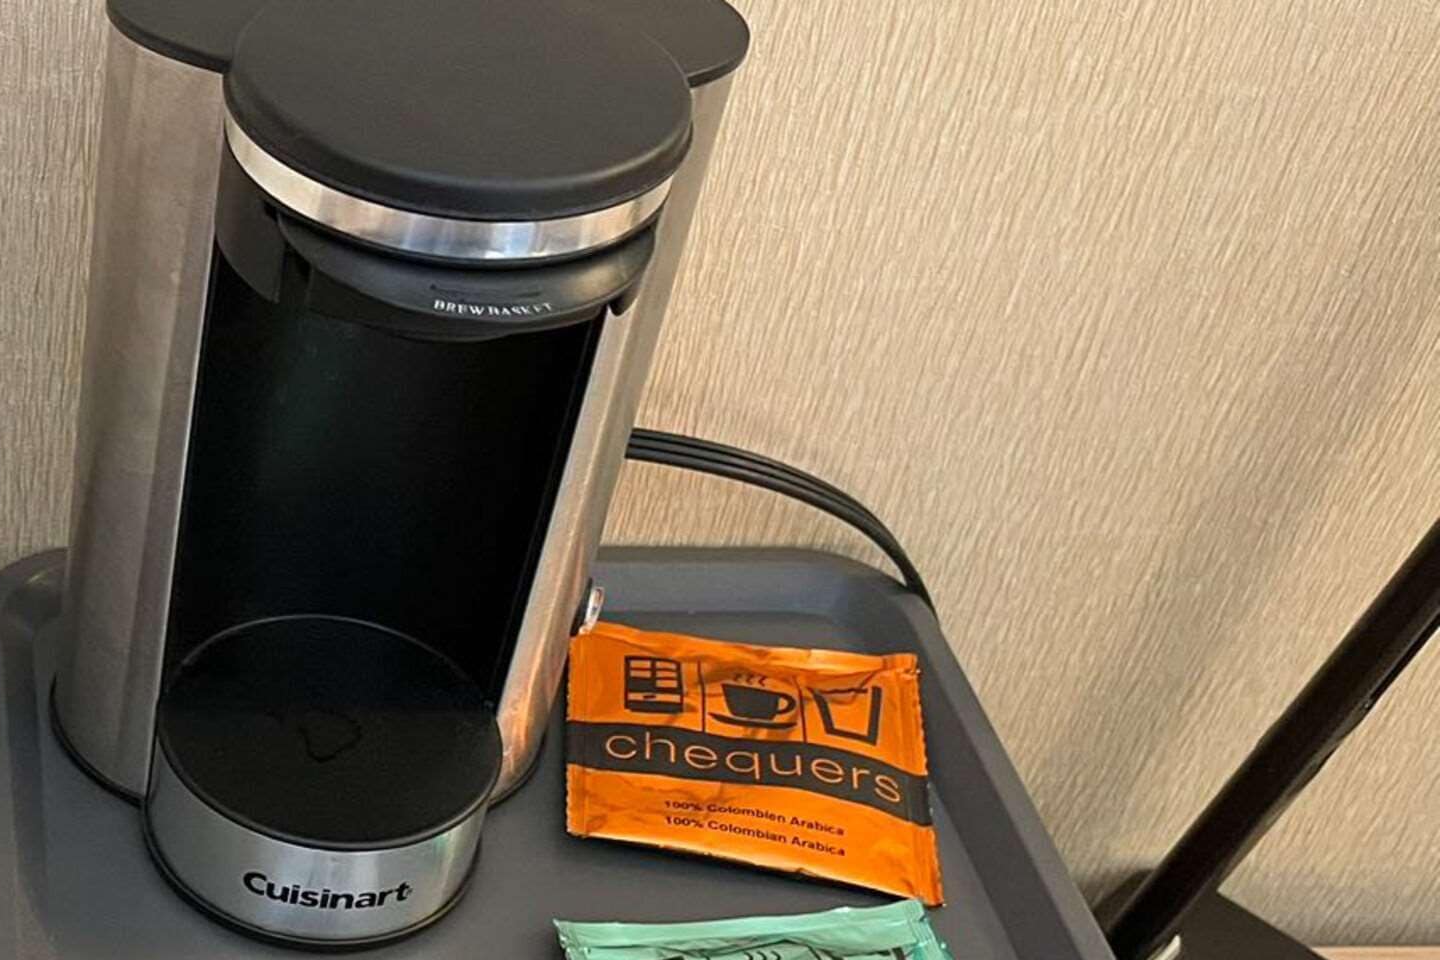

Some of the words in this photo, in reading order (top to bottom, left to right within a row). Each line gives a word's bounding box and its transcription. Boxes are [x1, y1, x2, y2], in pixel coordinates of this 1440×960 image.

[606, 732, 901, 803] chequers
[665, 800, 703, 812] 100%
[790, 817, 845, 836] Arabica
[665, 816, 704, 829] 100%
[708, 820, 787, 843] Colombian
[791, 836, 846, 856] Arabica
[243, 871, 410, 909] Cuisinart
